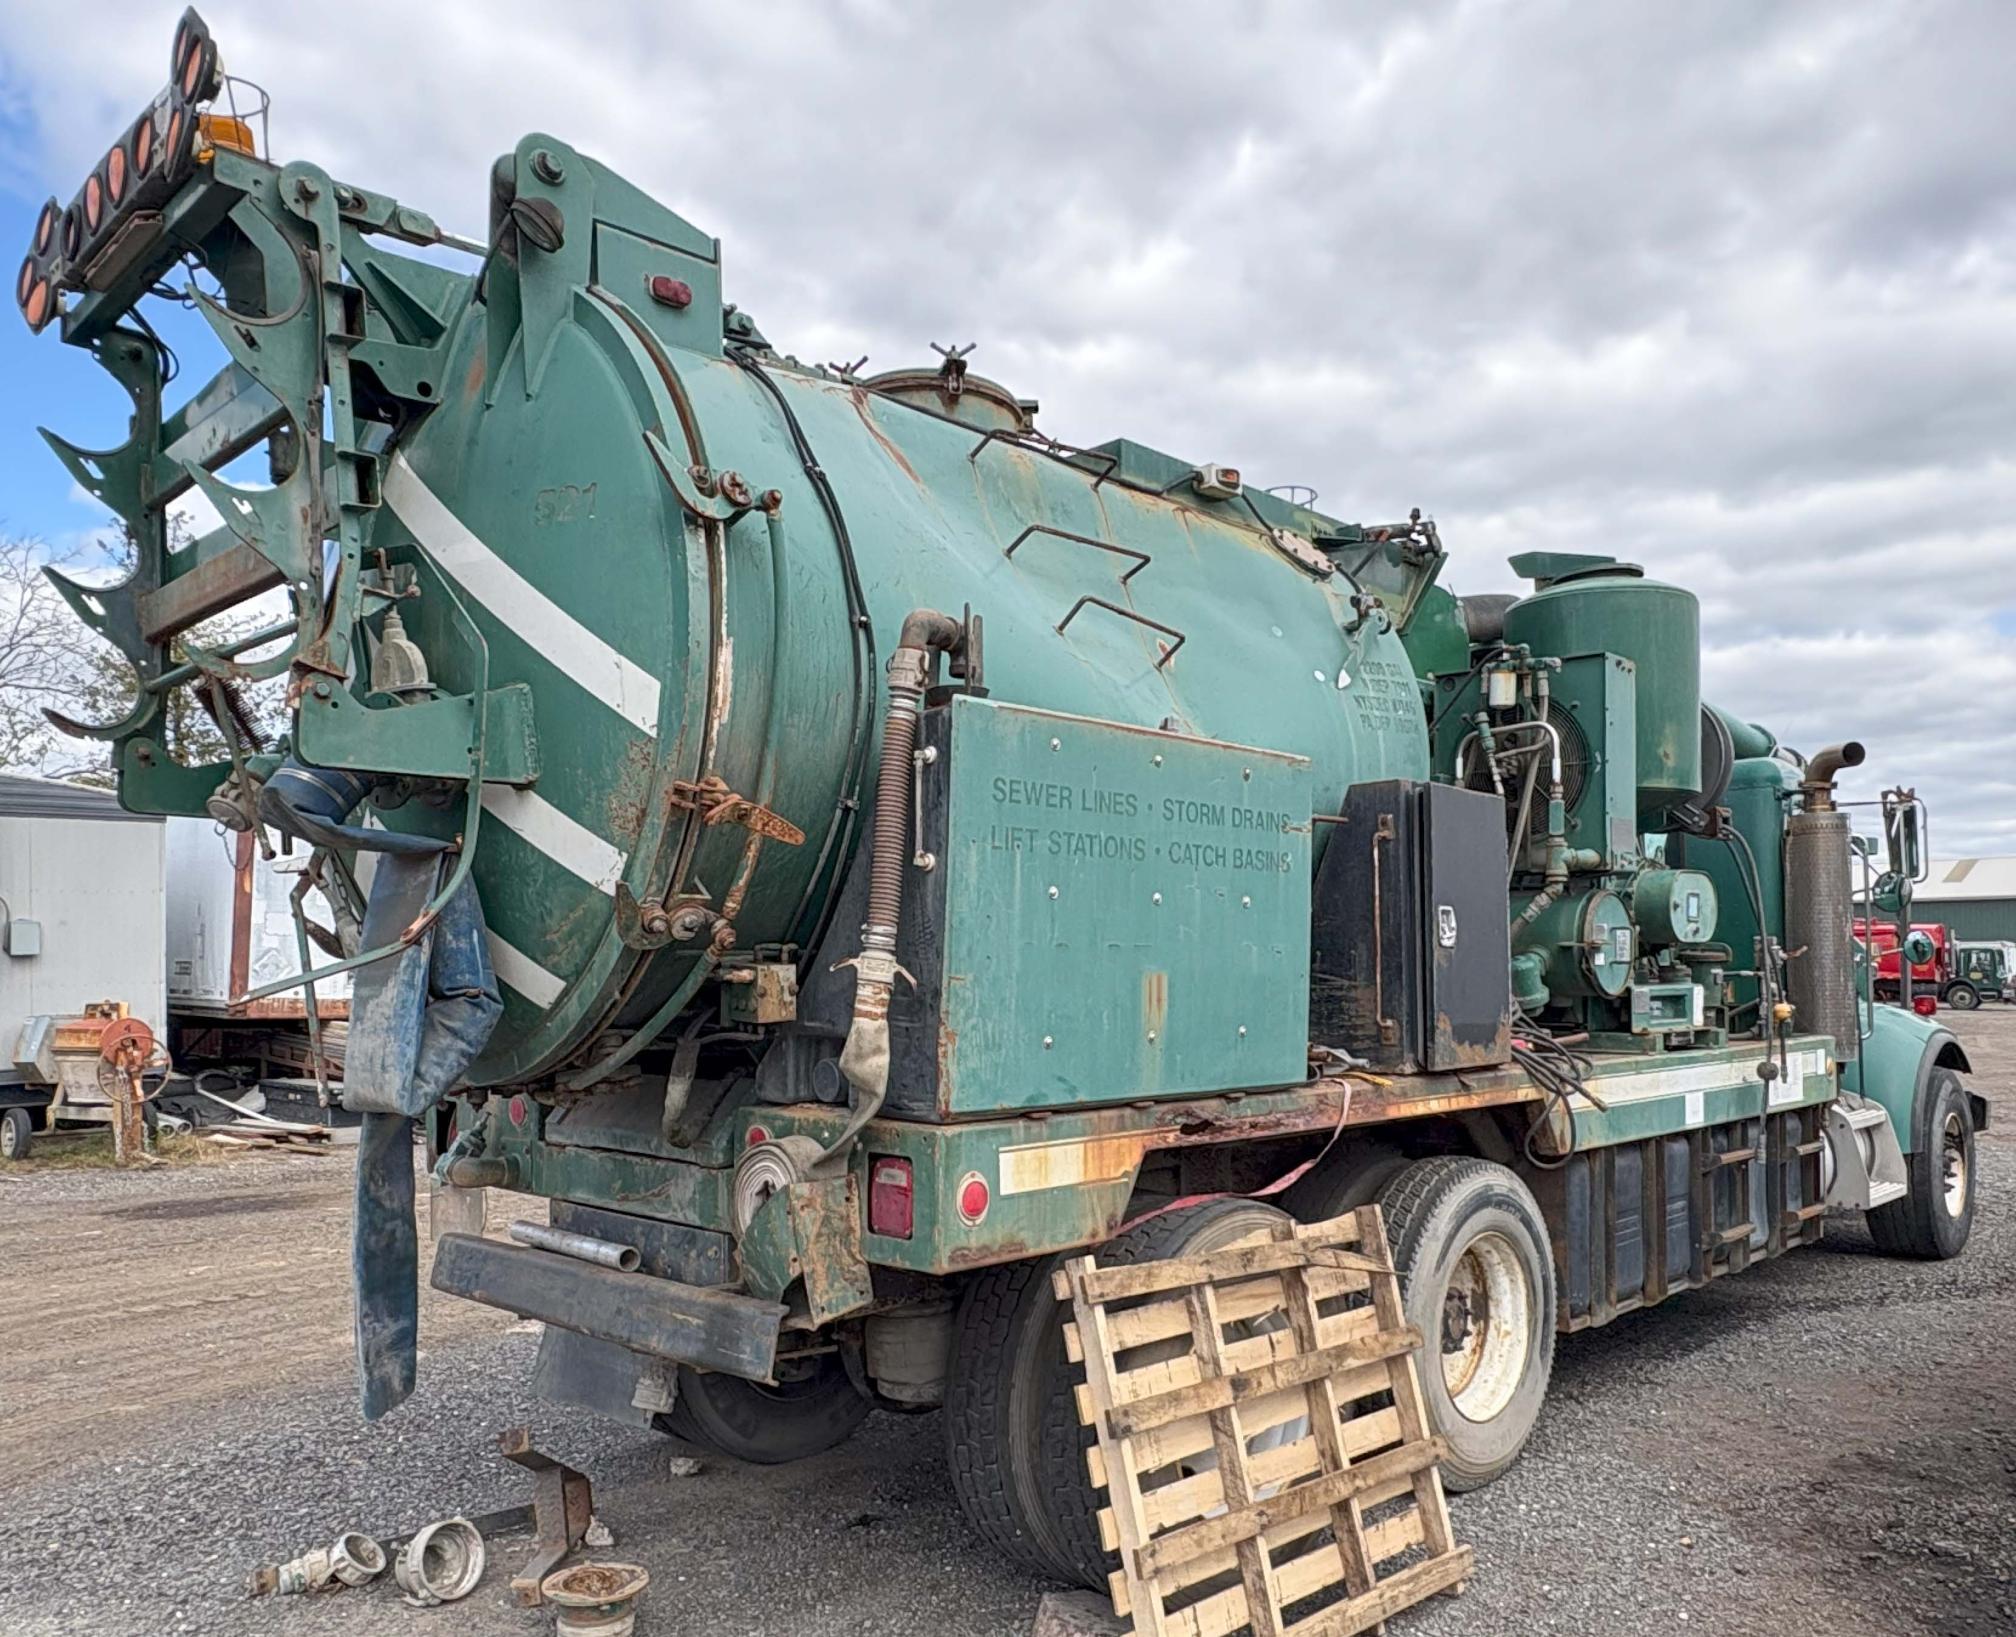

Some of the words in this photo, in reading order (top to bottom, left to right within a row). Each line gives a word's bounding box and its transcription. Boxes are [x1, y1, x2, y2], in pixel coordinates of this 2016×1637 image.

[992, 776, 1073, 810] SEWER
[1081, 788, 1138, 817] LINES
[1162, 798, 1225, 827] STORM
[1232, 806, 1292, 835] DRAINS
[991, 825, 1039, 853] LIFT
[1048, 830, 1146, 861] STATIONS
[1168, 841, 1226, 868] CATCH
[1233, 848, 1292, 873] BASINS
